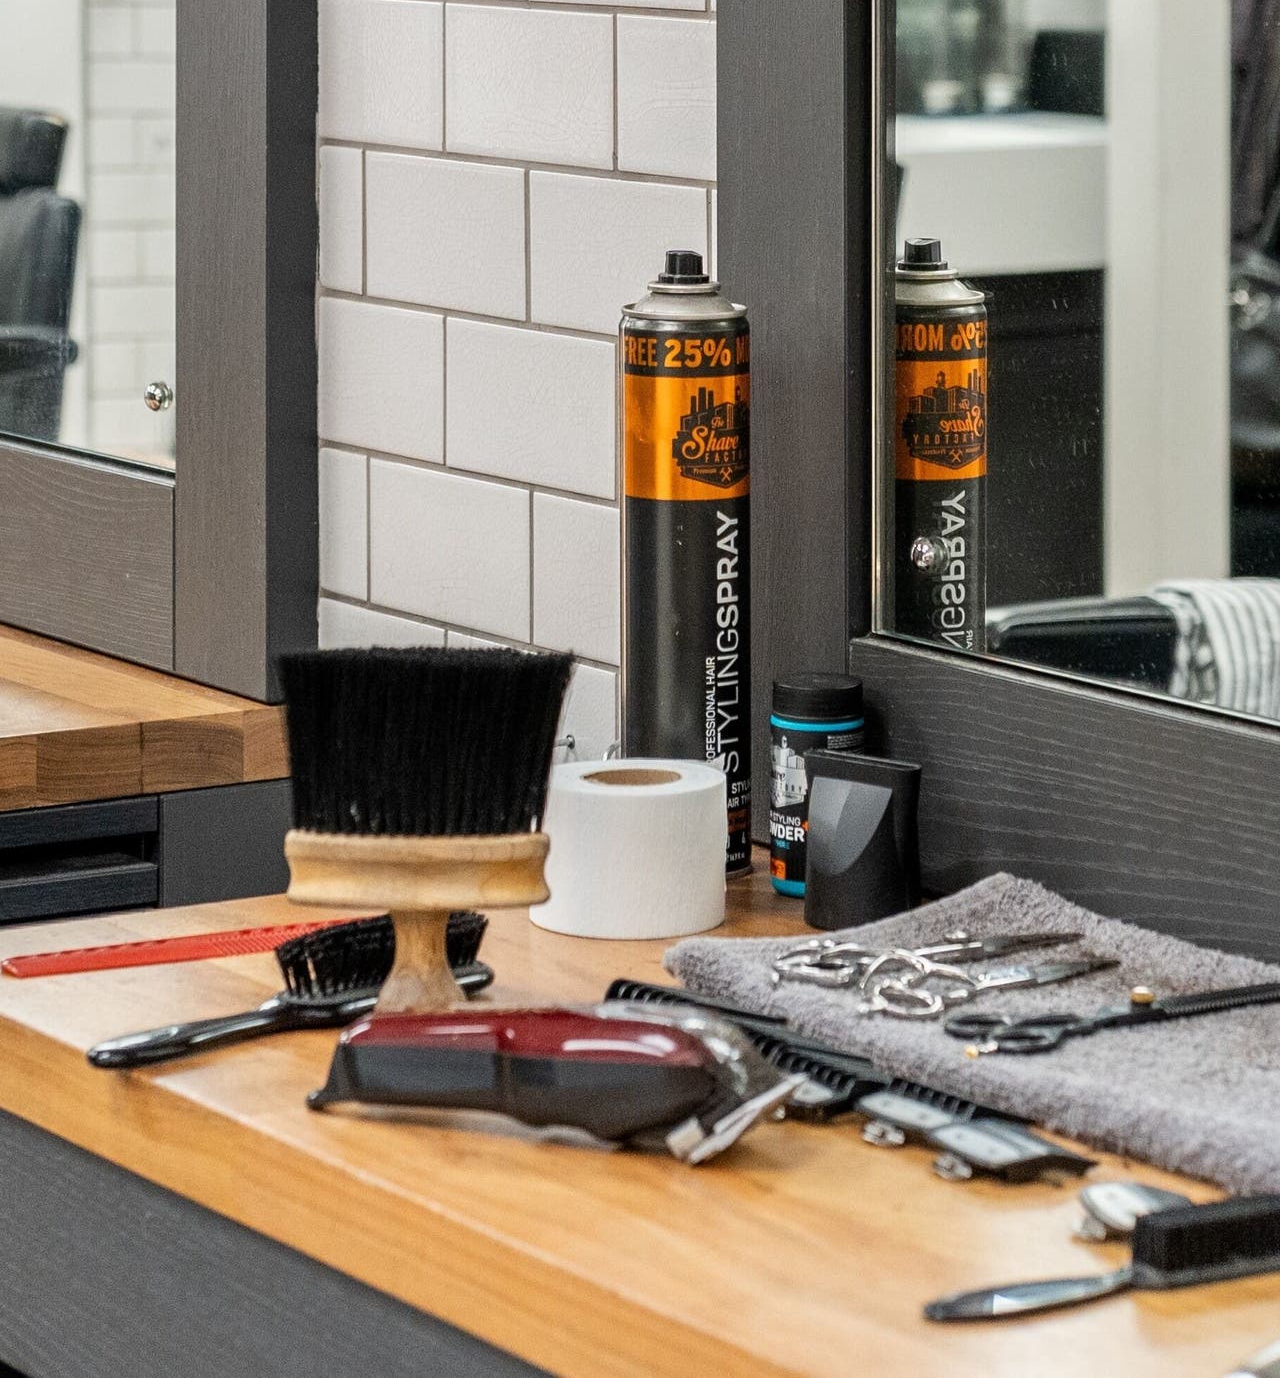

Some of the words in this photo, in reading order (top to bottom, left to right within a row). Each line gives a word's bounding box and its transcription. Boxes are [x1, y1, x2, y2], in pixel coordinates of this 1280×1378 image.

[664, 336, 732, 368] 25%
[681, 425, 739, 460] Shave
[704, 453, 743, 463] FACT
[716, 510, 740, 773] STYLINGSPRAY
[705, 656, 716, 684] HAIR
[727, 796, 740, 809] AIR
[770, 821, 805, 843] WDER
